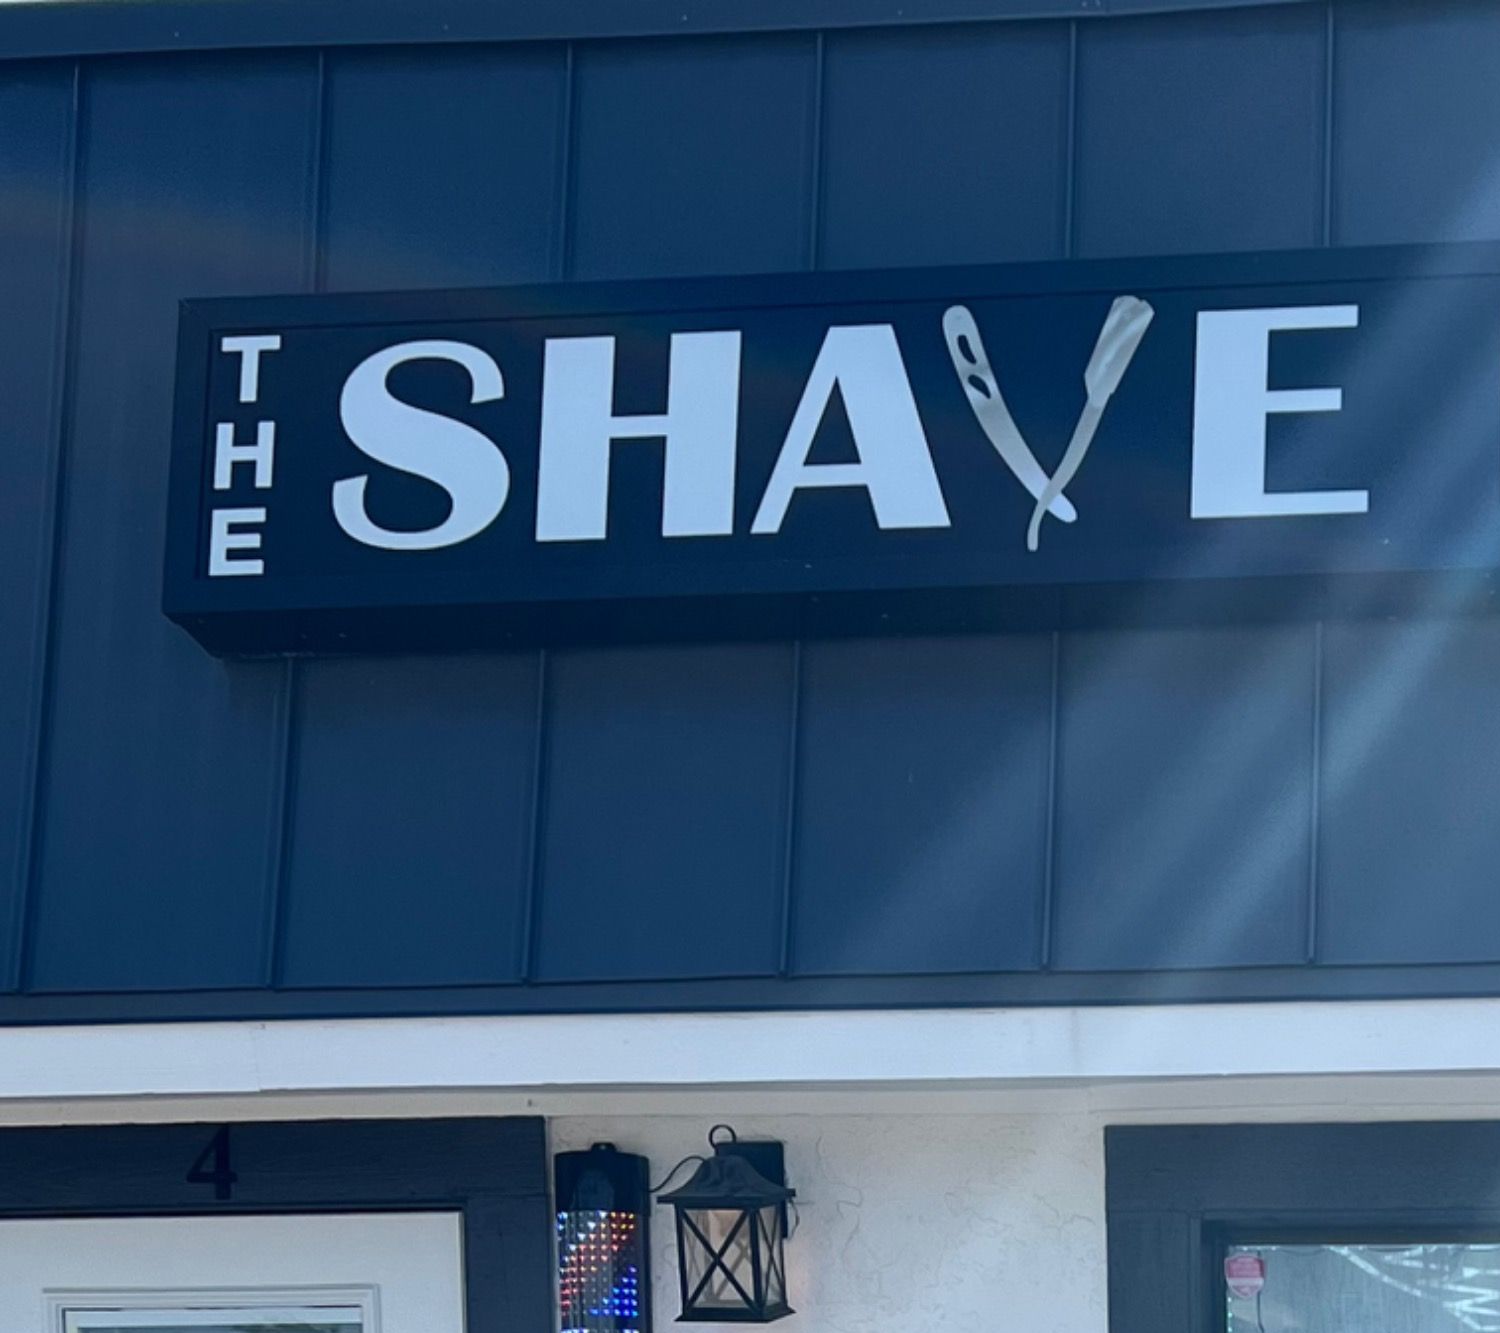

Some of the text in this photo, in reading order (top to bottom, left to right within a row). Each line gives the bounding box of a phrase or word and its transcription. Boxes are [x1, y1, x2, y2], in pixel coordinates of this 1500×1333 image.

[208, 334, 282, 577] THE
[331, 294, 1369, 552] SHAVE
[186, 1124, 239, 1201] 4
